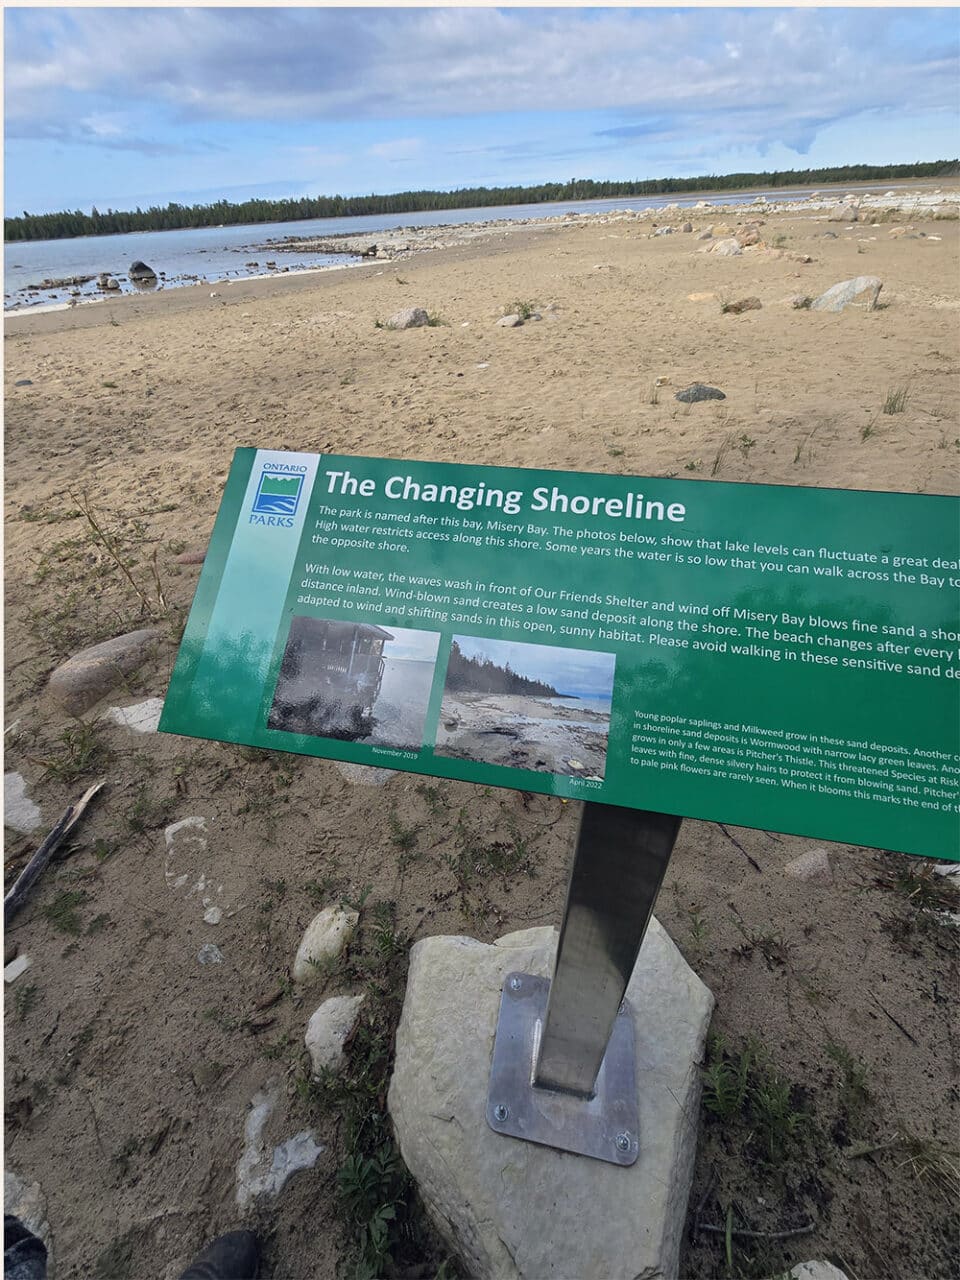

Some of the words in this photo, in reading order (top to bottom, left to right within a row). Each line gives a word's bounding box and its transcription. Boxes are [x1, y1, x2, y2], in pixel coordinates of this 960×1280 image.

[262, 462, 307, 472] ONTARIO
[248, 514, 294, 528] PARKS
[325, 470, 375, 496] The
[384, 475, 523, 514] Changing
[530, 486, 686, 522] Shoreline
[311, 533, 329, 544] the
[330, 537, 375, 549] opposite
[377, 540, 409, 552] shore.
[319, 505, 337, 515] The
[338, 508, 362, 518] park
[363, 509, 372, 519] is
[374, 512, 411, 522] named
[412, 513, 438, 525] after
[440, 515, 460, 527] this
[462, 517, 483, 531] bay,
[486, 520, 524, 534] Misery
[526, 523, 549, 536] Bay.
[552, 525, 573, 537] The
[575, 528, 616, 541] photos
[619, 531, 657, 546] below,
[660, 535, 693, 547] show
[696, 538, 721, 550] that
[724, 540, 750, 552] lake
[753, 542, 789, 555] levels
[792, 548, 815, 557] can
[818, 547, 877, 563] fluctuate
[881, 555, 889, 564] a
[892, 556, 928, 567] great
[300, 577, 344, 592] distance
[345, 583, 381, 596] inland.
[385, 587, 450, 603] Wind-blown
[452, 596, 480, 607] sand
[481, 600, 523, 612] creates
[526, 604, 533, 613] a
[536, 603, 558, 616] low
[560, 608, 589, 619] sand
[591, 609, 636, 625] deposit
[639, 615, 674, 631] along
[677, 619, 698, 632] the
[701, 622, 741, 636] shore.
[744, 626, 769, 639] The
[773, 628, 813, 644] beach
[816, 634, 873, 651] changes
[876, 640, 910, 654] after
[913, 647, 953, 662] every
[634, 710, 659, 722] Young
[659, 715, 687, 724] poplar
[688, 718, 722, 730] saplings
[723, 723, 740, 731] and
[741, 724, 783, 737] Milkweed
[785, 732, 808, 740] grow
[809, 734, 818, 742] in
[819, 735, 845, 746] these
[846, 740, 868, 749] sand
[869, 741, 911, 755] deposits.
[912, 747, 952, 760] Another
